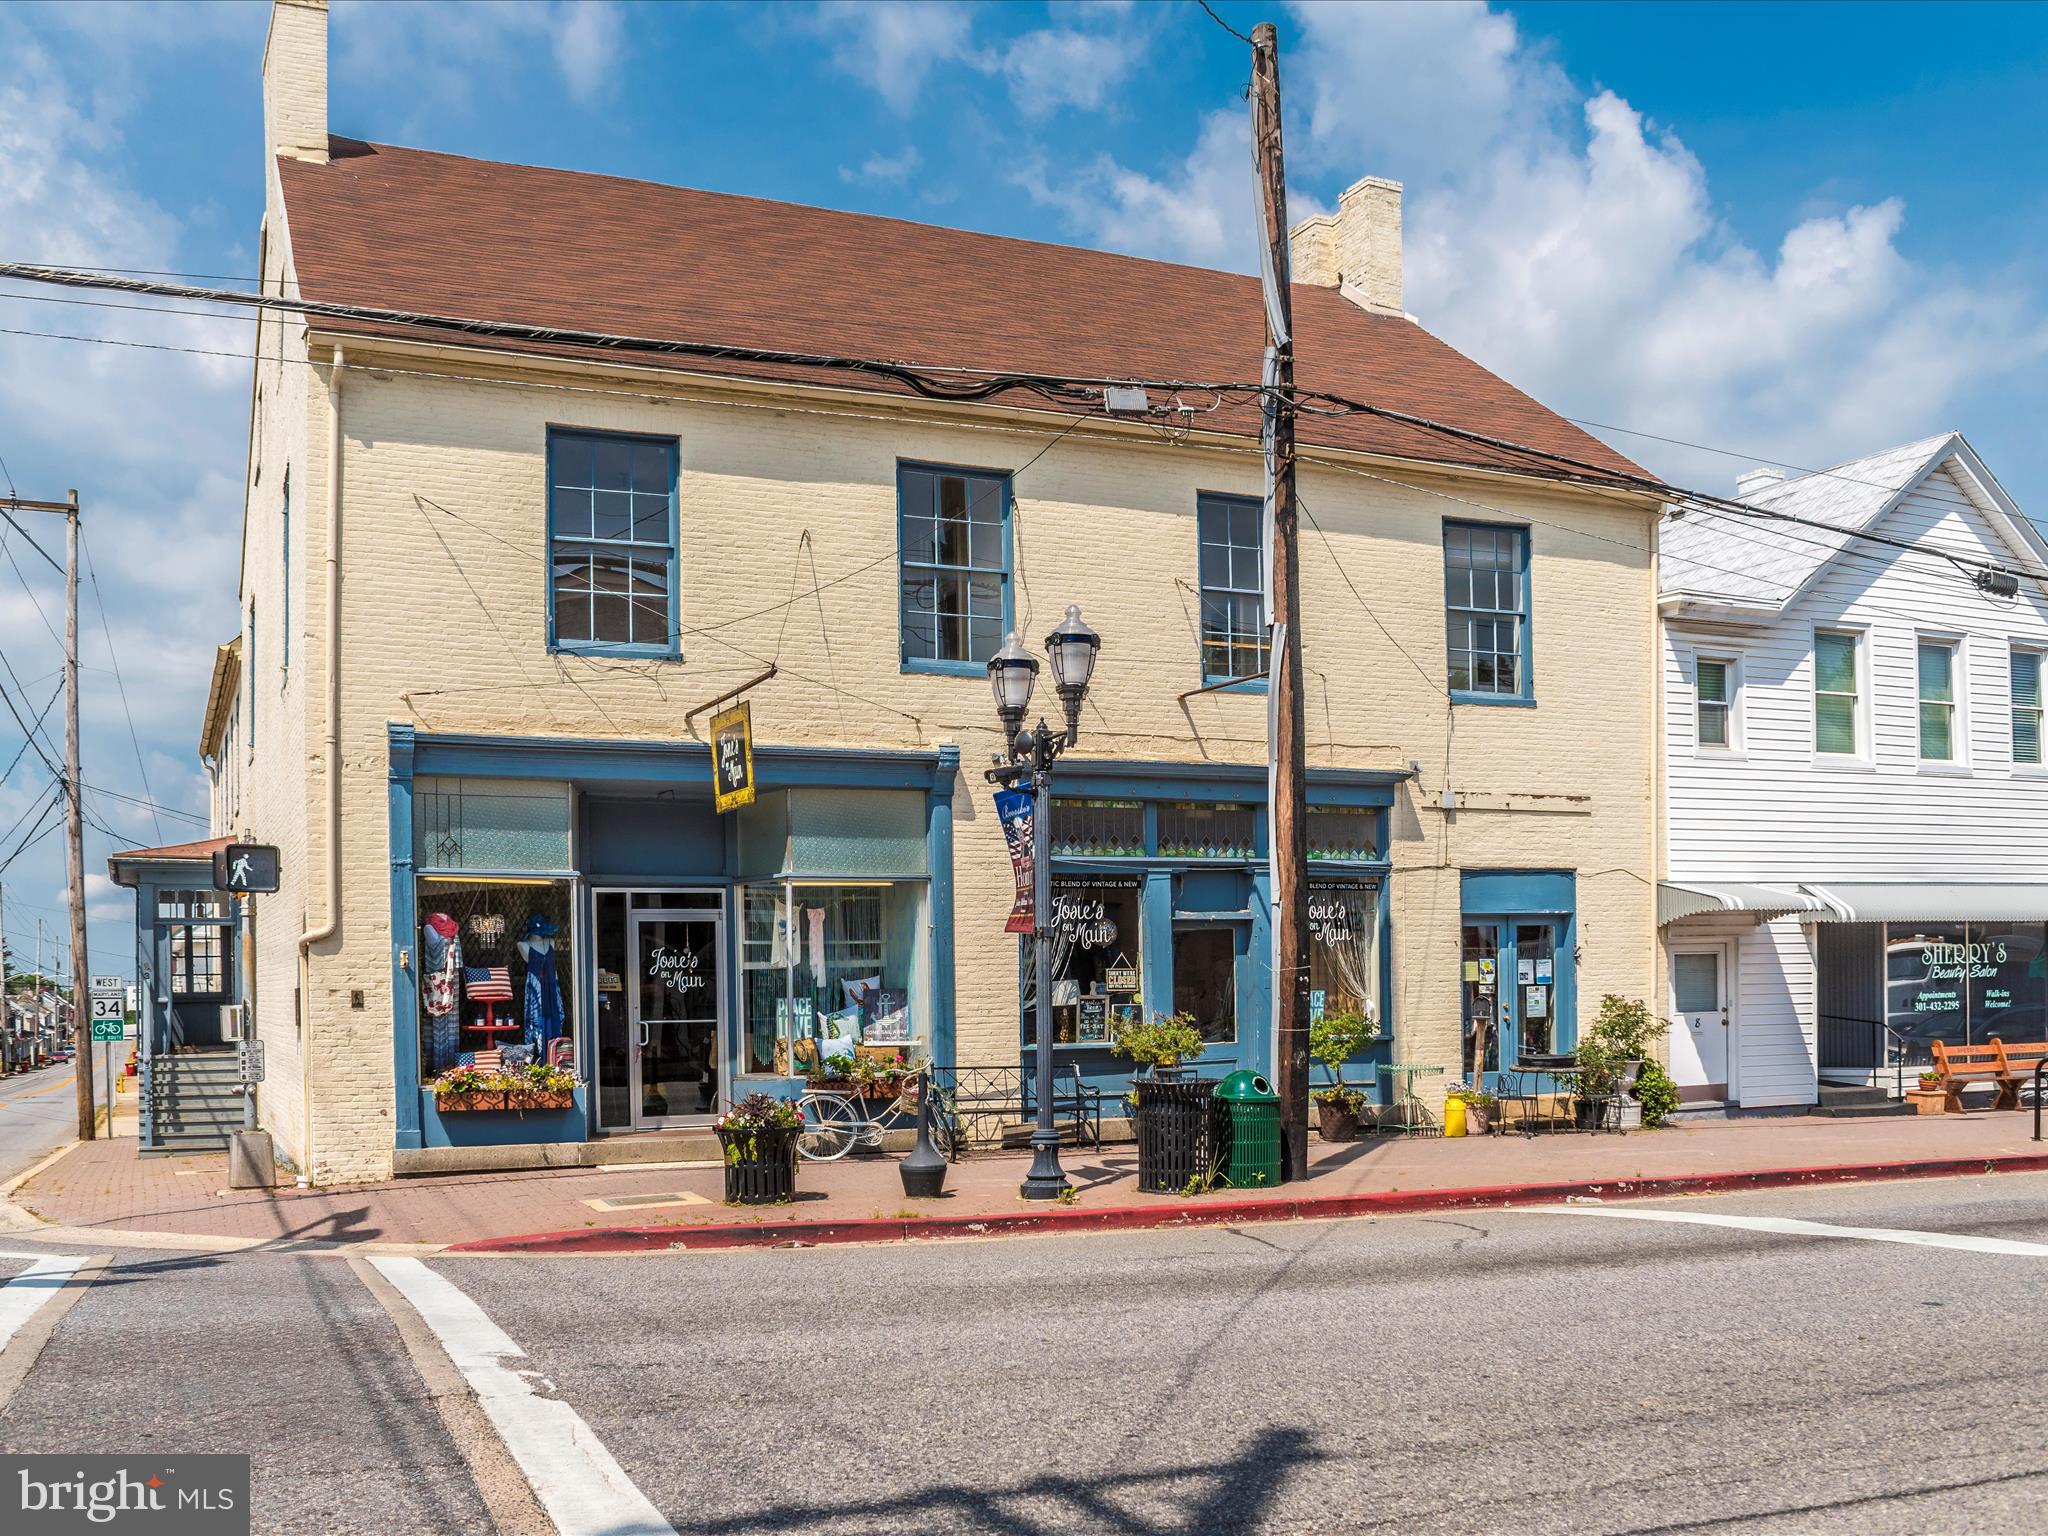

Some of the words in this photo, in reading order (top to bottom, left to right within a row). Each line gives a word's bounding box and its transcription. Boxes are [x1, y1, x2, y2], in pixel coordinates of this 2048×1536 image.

[1050, 894, 1105, 928] Josie's
[1308, 895, 1346, 920] osie's
[1062, 922, 1075, 932] on
[1069, 922, 1111, 950] Main
[1309, 921, 1320, 931] on
[1315, 921, 1353, 948] Main
[649, 946, 699, 976] Josie's
[1921, 942, 2008, 965] SHERRY'S
[660, 970, 672, 979] on
[666, 968, 706, 994] Main
[1108, 976, 1136, 985] CLOSED
[1931, 965, 1967, 983] Beauty
[1970, 964, 1998, 978] Salon
[95, 978, 119, 988] WEST
[1917, 990, 1957, 1001] Appointments
[1986, 989, 2010, 998] Walk-ins
[95, 1000, 121, 1016] 34
[1915, 1001, 1960, 1011] 301-432-2295
[1984, 1000, 2012, 1008] Welcome!
[1695, 1017, 1701, 1028] 8
